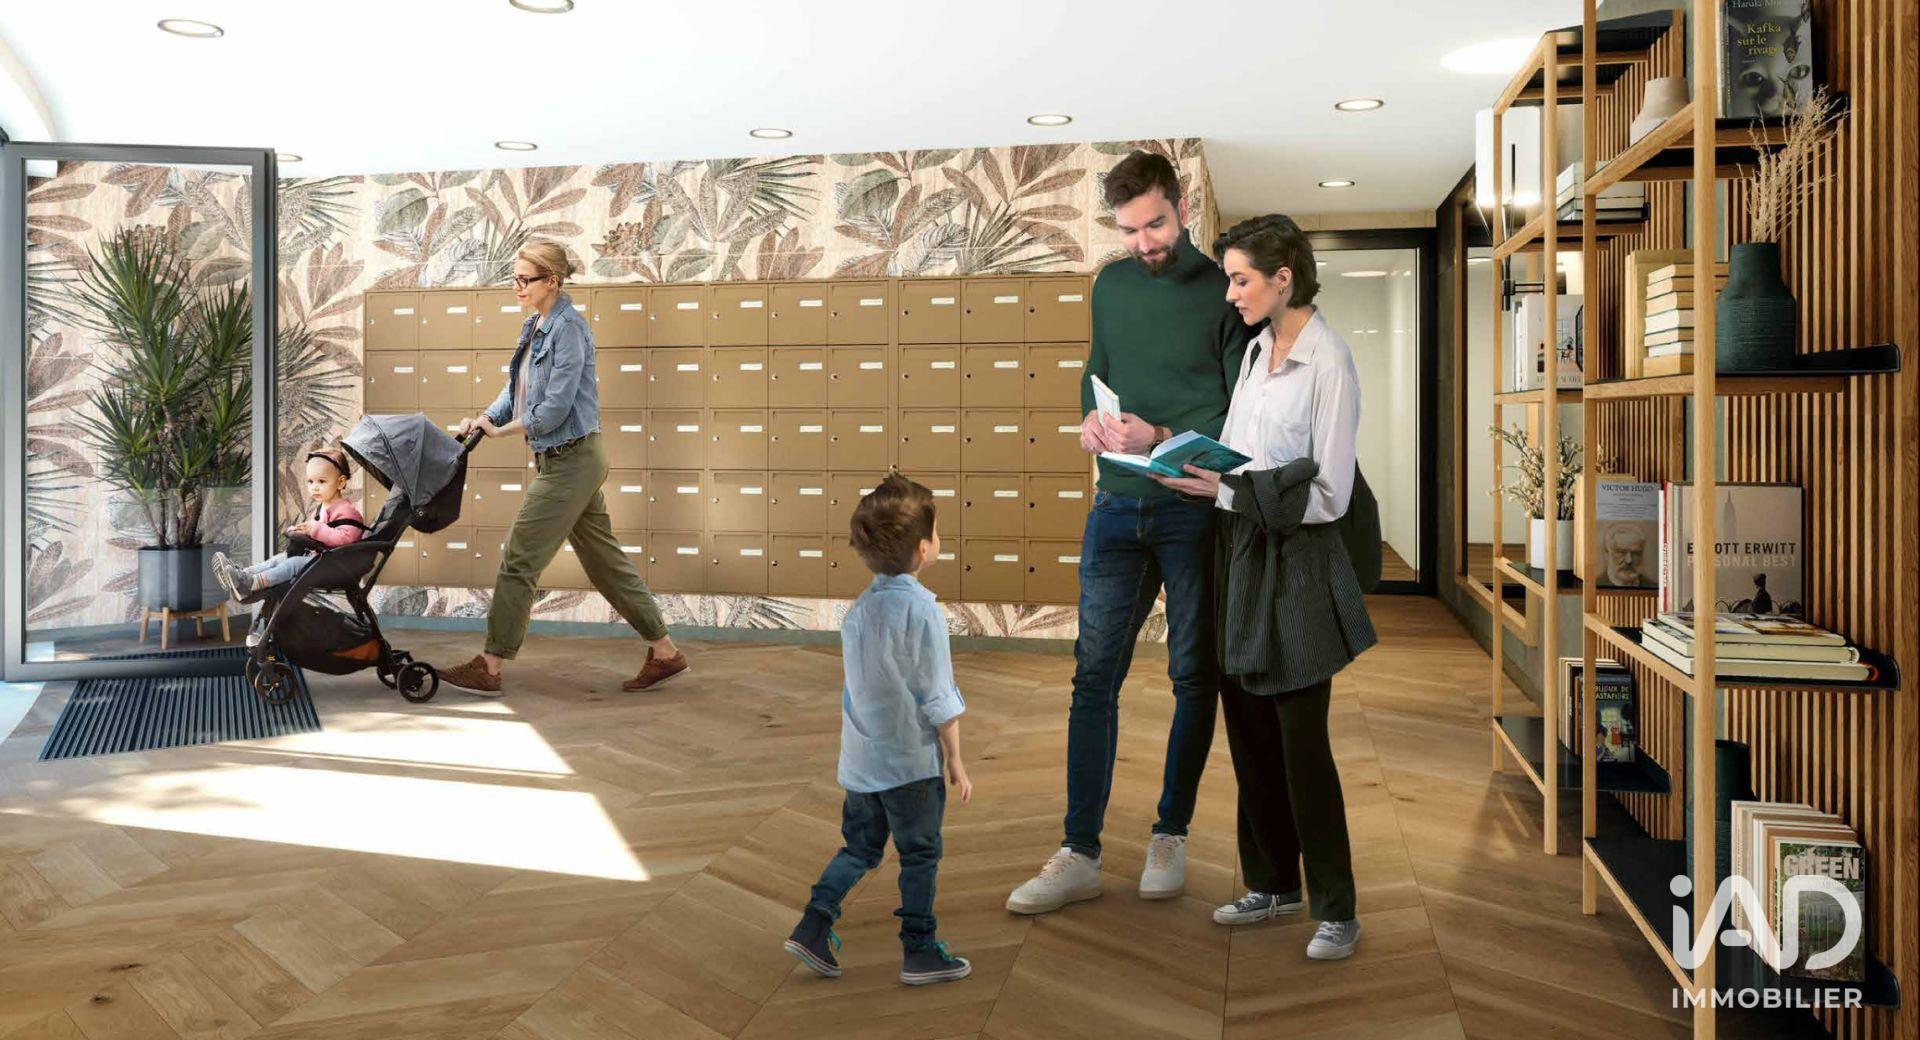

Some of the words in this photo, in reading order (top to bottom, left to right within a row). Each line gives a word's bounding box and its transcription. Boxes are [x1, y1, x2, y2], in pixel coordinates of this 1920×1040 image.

[1747, 23, 1781, 33] Kafka
[1737, 38, 1755, 46] sur
[1757, 34, 1767, 44] le
[1601, 484, 1630, 492] VICTOR
[1632, 484, 1654, 493] HUGO
[1687, 542, 1740, 554] EOTT
[1745, 542, 1796, 554] ERWITT
[1687, 555, 1758, 567] PSONAL
[1763, 555, 1796, 567] BEST
[1784, 854, 1860, 880] GREEN
